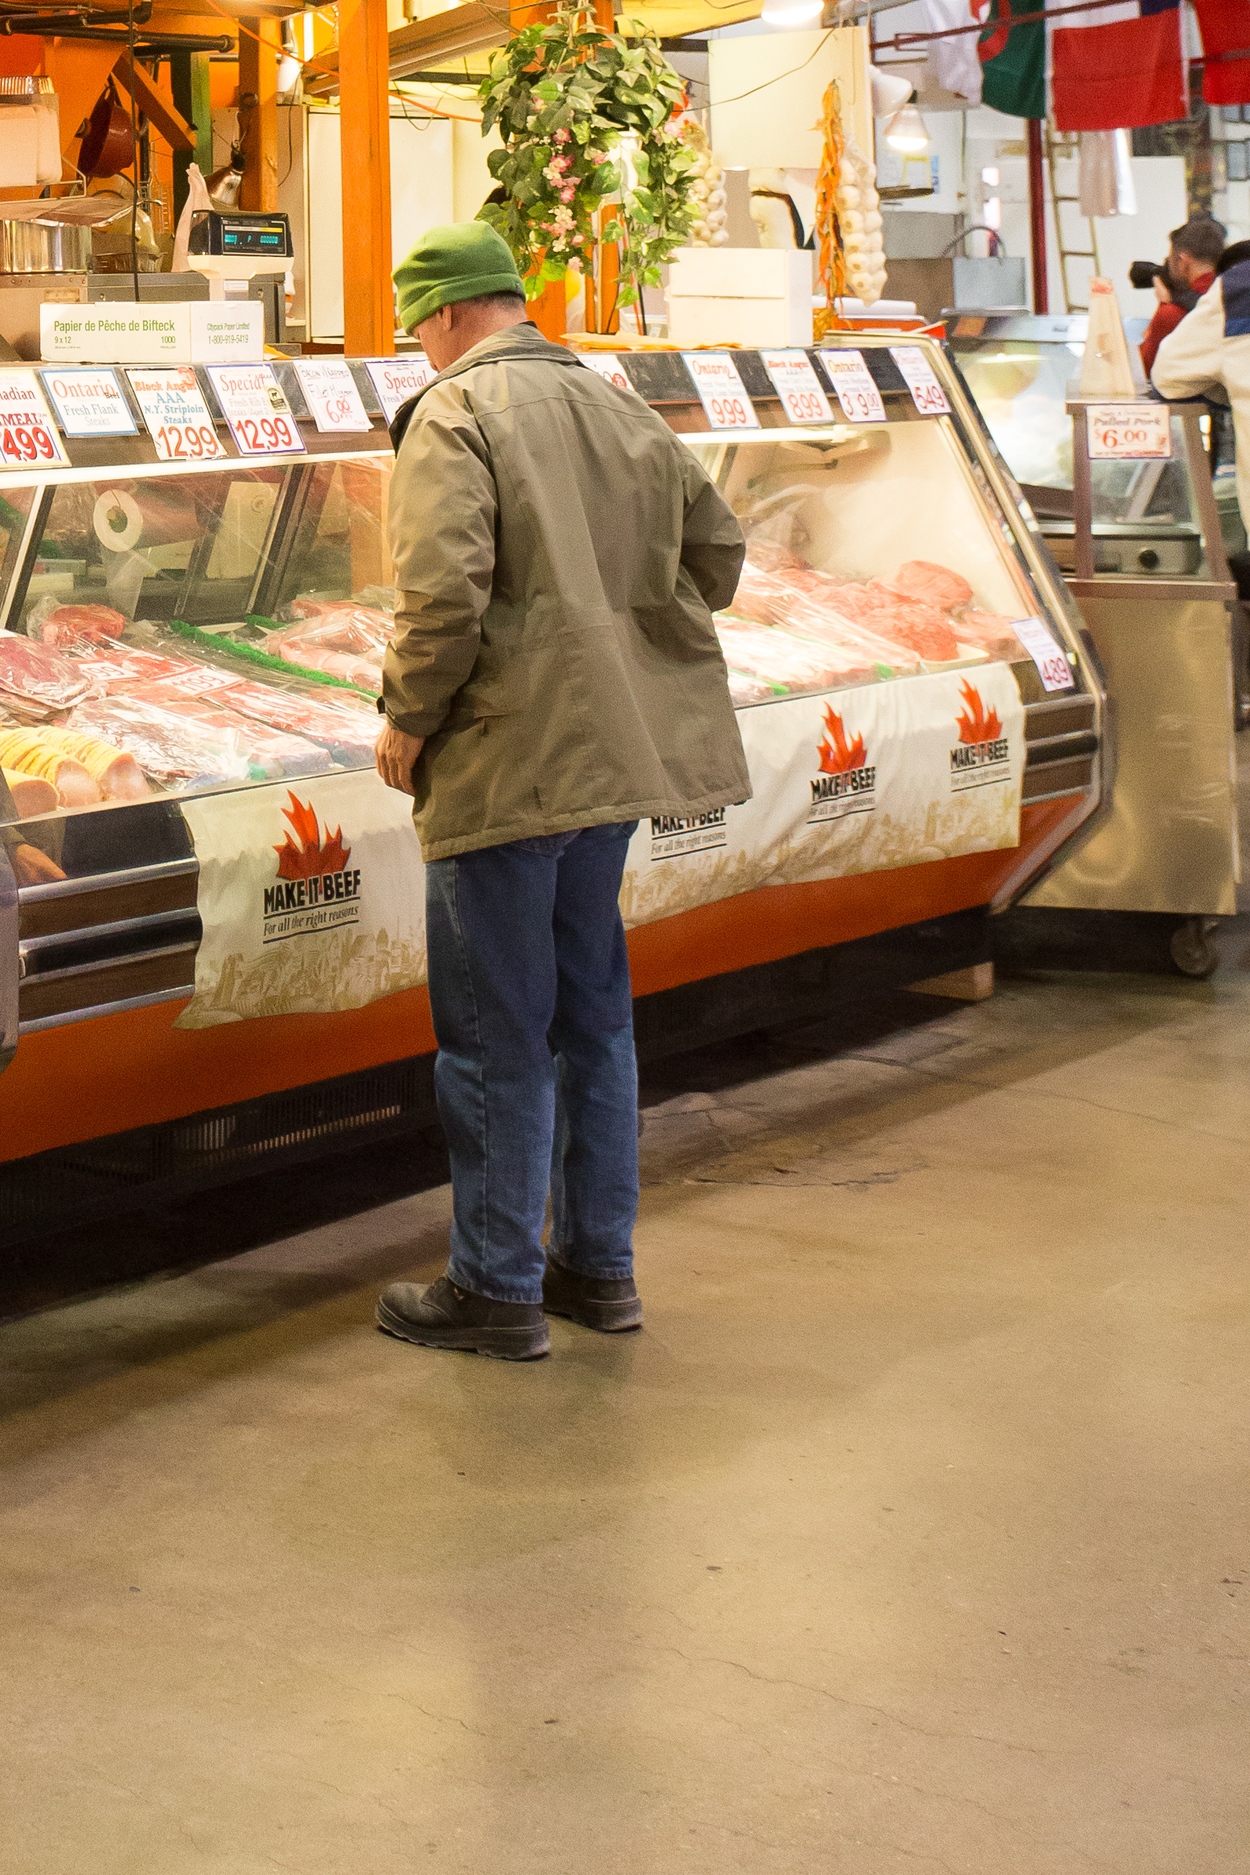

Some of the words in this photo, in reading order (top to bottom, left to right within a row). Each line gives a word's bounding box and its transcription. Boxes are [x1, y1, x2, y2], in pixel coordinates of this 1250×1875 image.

[54, 320, 82, 333] Papier
[85, 320, 95, 331] de
[98, 320, 127, 331] Pêche
[129, 320, 139, 331] de
[142, 320, 175, 331] Bifteck
[55, 336, 59, 344] 9
[64, 336, 72, 344] 12
[161, 336, 176, 344] 1000
[208, 333, 249, 345] 1-800-919-5419
[692, 360, 730, 375] Ontario
[828, 360, 863, 373] Ontario
[52, 378, 116, 399] Ontario
[135, 381, 163, 392] Black
[220, 373, 265, 396] Special
[384, 370, 427, 395] Special
[156, 392, 186, 404] AAA
[63, 404, 90, 416] Fresh
[93, 403, 120, 415] Flank
[144, 406, 163, 414] N.Y.
[165, 405, 204, 418] Striploin
[86, 416, 111, 426] Steaks
[163, 416, 193, 424] Steaks
[810, 775, 841, 802] MAKE
[851, 766, 875, 791] BEEF
[264, 881, 306, 916] MAKE
[308, 877, 319, 904] IT
[323, 869, 361, 902] BEEF
[263, 922, 276, 937] For
[278, 918, 290, 933] all
[291, 915, 304, 930] the
[305, 911, 327, 930] right
[328, 905, 359, 923] reasons
